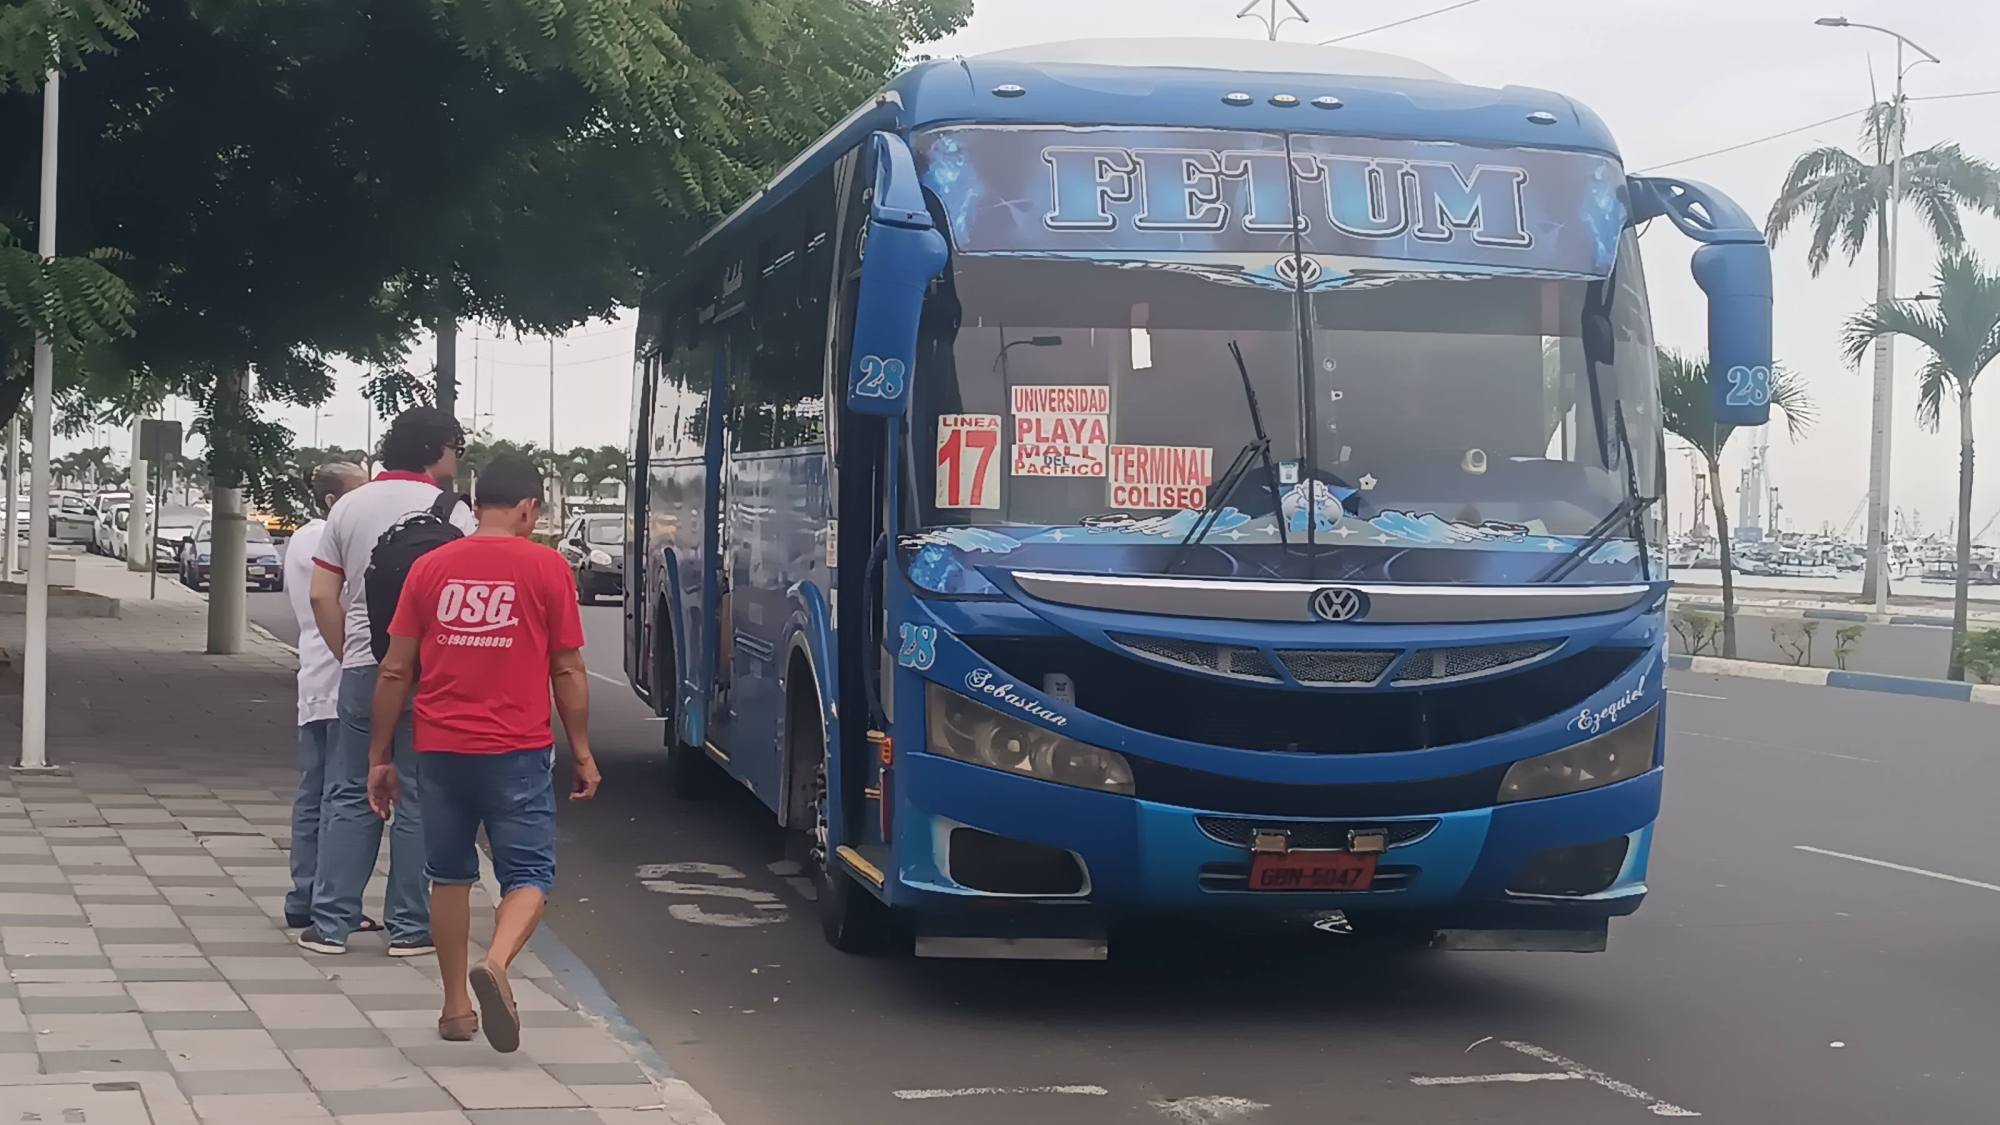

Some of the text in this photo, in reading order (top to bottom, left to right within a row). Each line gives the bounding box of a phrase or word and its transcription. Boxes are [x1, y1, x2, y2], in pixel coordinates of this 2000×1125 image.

[1042, 146, 1533, 248] FETUM
[856, 355, 905, 399] 28
[1726, 365, 1770, 406] 28
[1014, 388, 1108, 412] UNIVERSIDAD
[942, 416, 999, 427] LINEA
[1017, 418, 1107, 444] PLAYA
[938, 430, 997, 506] 17
[1014, 461, 1103, 475] PACIFICO
[1017, 445, 1097, 460] MALL
[1043, 456, 1070, 467] DEL
[1111, 447, 1212, 485] TERMINAL
[1113, 485, 1204, 508] COLISEO
[437, 584, 516, 623] OSG
[1315, 589, 1360, 620] VW
[899, 622, 937, 670] 28
[965, 668, 1067, 727] Sebastian
[1567, 675, 1645, 733] Ezequiel
